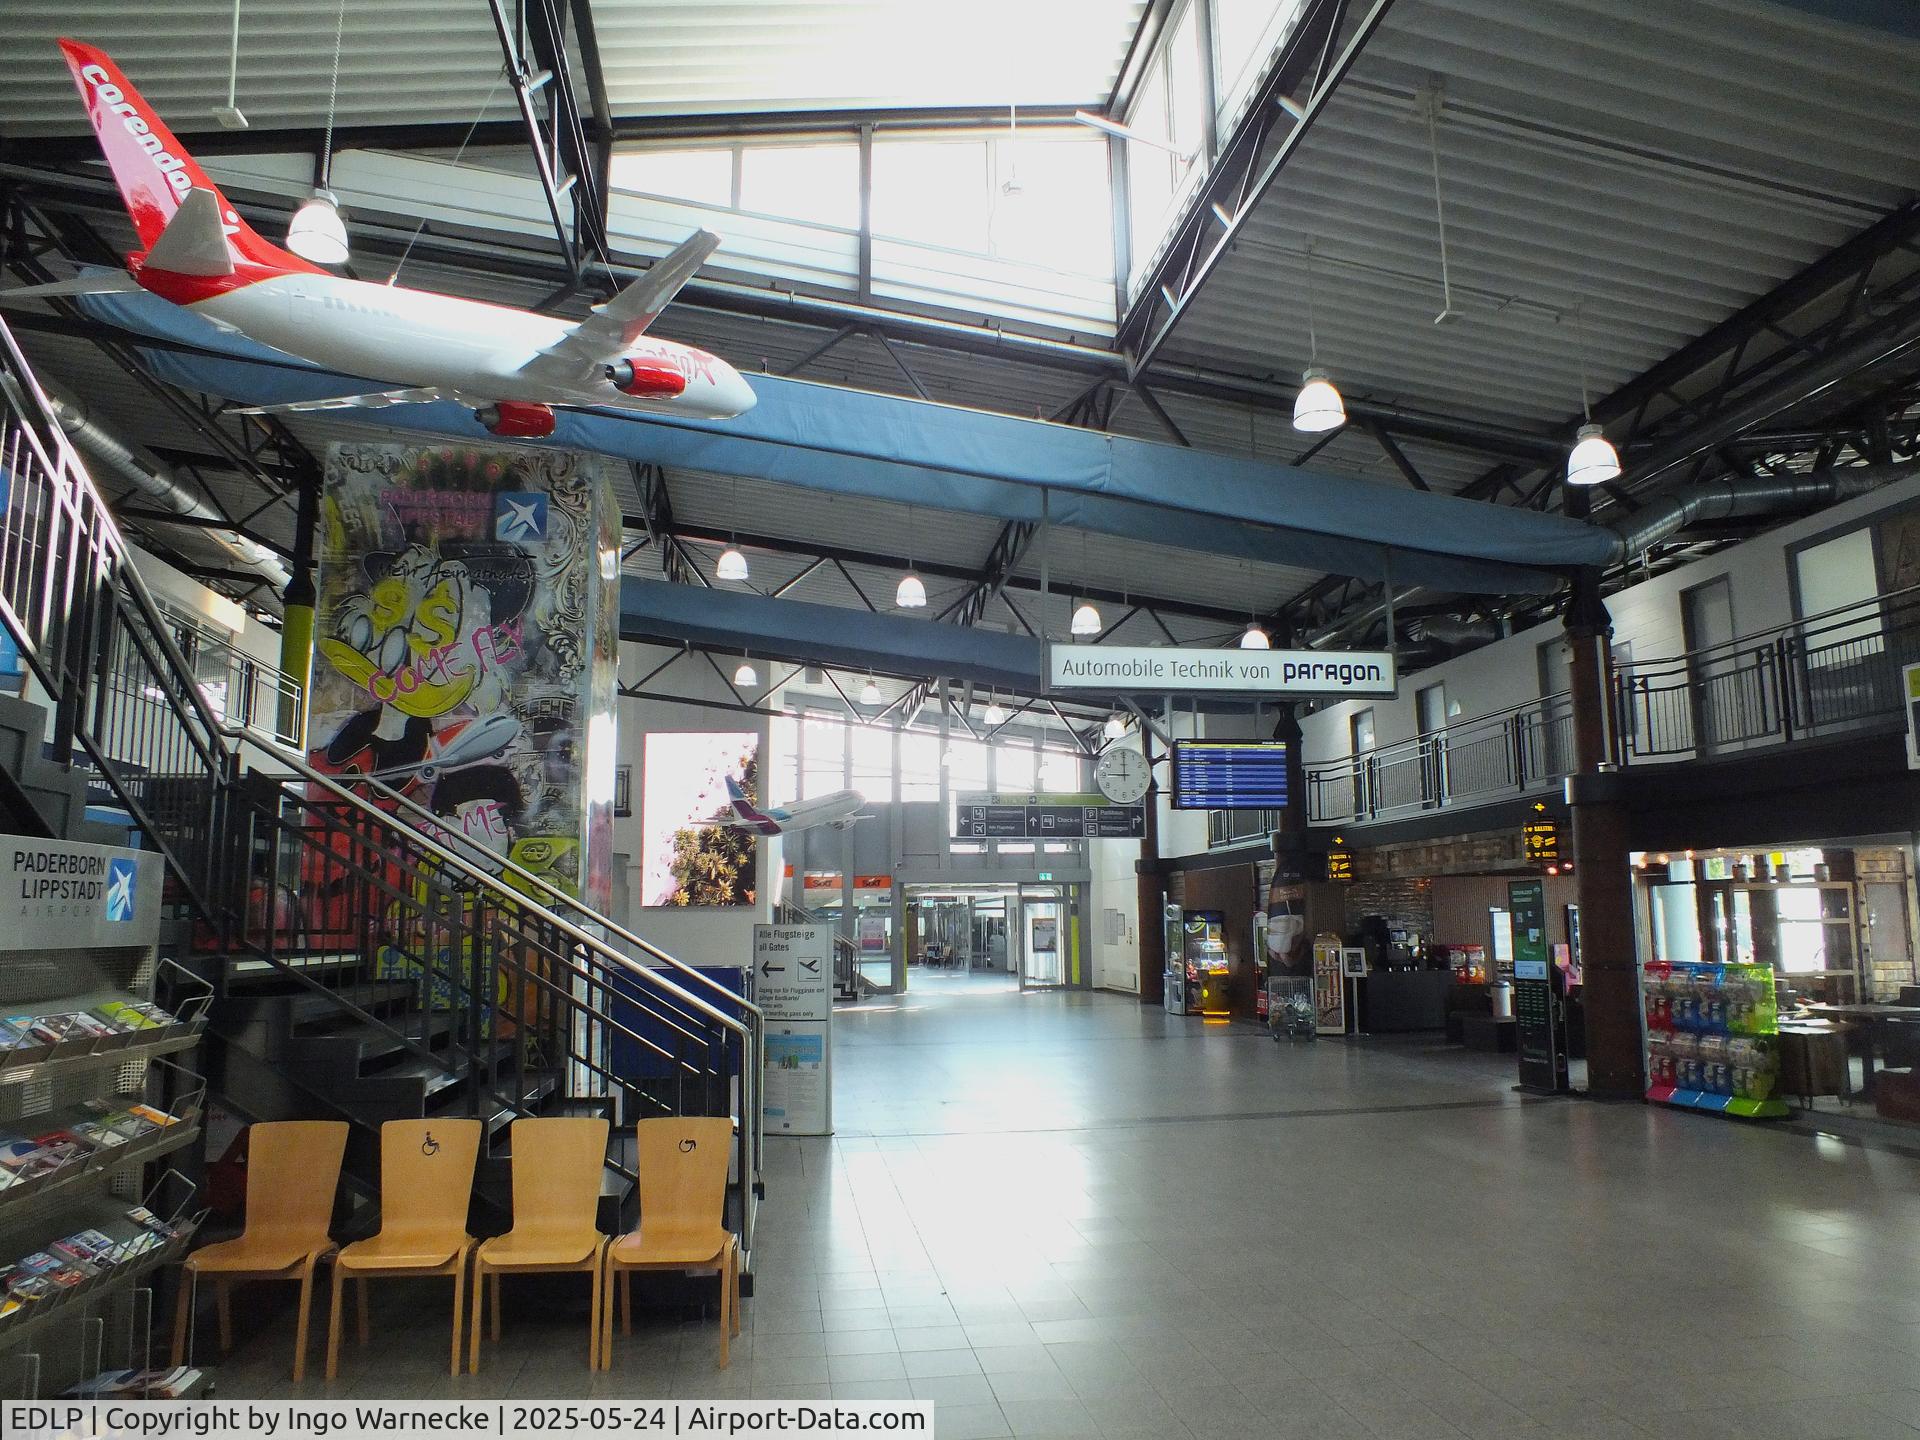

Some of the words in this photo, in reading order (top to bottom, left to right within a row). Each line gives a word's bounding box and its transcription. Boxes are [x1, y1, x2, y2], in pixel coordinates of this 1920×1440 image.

[82, 64, 194, 200] corendo
[368, 641, 470, 702] COME
[471, 616, 526, 673] FLY
[1062, 659, 1164, 677] Automobile
[1170, 660, 1233, 679] Technik
[1240, 665, 1270, 679] von
[463, 801, 507, 842] ME
[13, 851, 107, 875] PADERBORN
[21, 879, 103, 900] LIPPSTADT
[759, 929, 772, 939] Alle
[773, 929, 815, 940] Flugsteige
[759, 943, 767, 951] all
[769, 942, 790, 951] Gates
